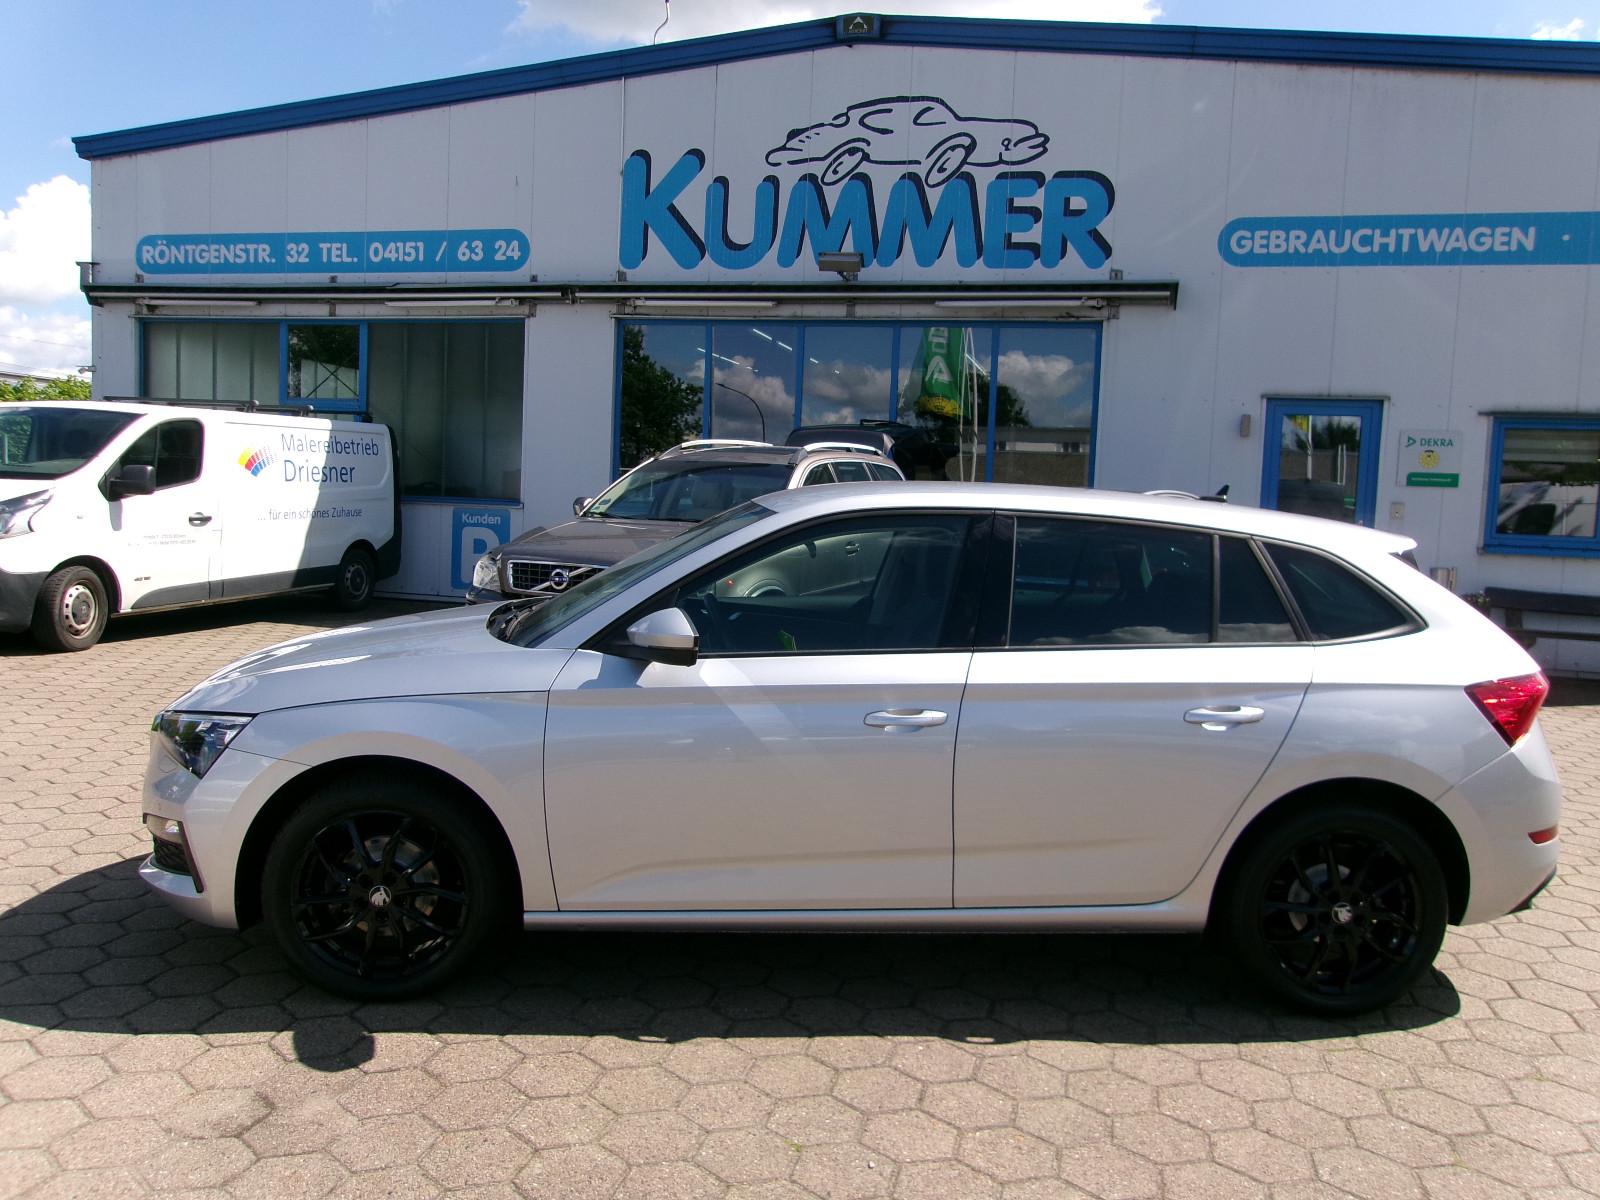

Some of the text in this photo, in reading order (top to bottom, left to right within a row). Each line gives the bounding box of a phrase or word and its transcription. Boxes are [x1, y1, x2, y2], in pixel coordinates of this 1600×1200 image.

[618, 148, 1115, 270] KUMMER
[1230, 226, 1537, 255] GEBRAUCHTWAGEN
[142, 240, 521, 266] RÖNTGENSTR. 32 TEL. 04151 / 63 24
[281, 434, 379, 456] Malereibetrieb
[1420, 438, 1454, 447] DEKRA
[284, 459, 356, 483] Driesner
[269, 508, 282, 521] für
[283, 509, 297, 520] ein
[331, 507, 363, 519] Zuhause
[462, 513, 501, 524] Kunden
[461, 527, 500, 583] P
